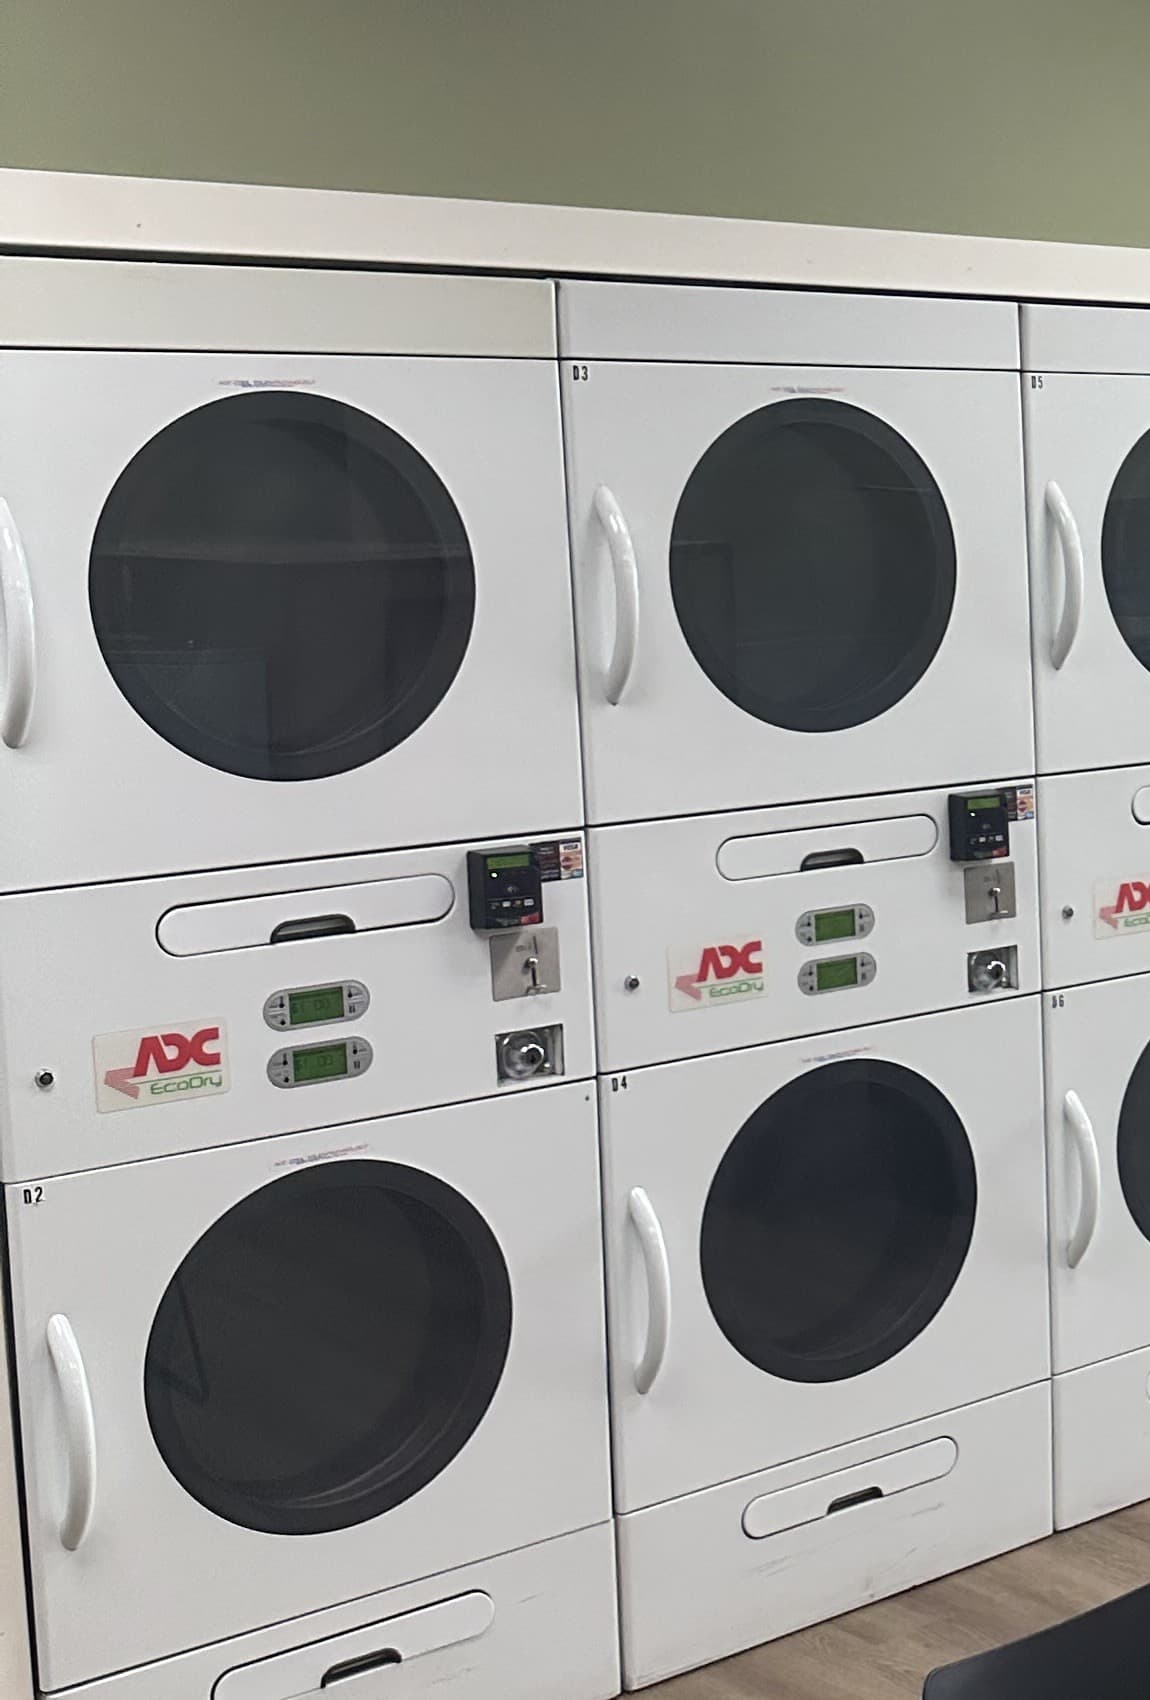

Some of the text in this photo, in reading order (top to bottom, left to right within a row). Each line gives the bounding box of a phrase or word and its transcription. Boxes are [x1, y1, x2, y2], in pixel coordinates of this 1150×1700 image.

[572, 365, 588, 381] D3
[1031, 375, 1043, 389] D5
[697, 941, 763, 982] ADC
[709, 980, 764, 999] EcoDry
[132, 1027, 221, 1077] ADC
[150, 1074, 223, 1095] EcoDry
[611, 1076, 628, 1092] D4
[23, 1186, 45, 1205] D2
